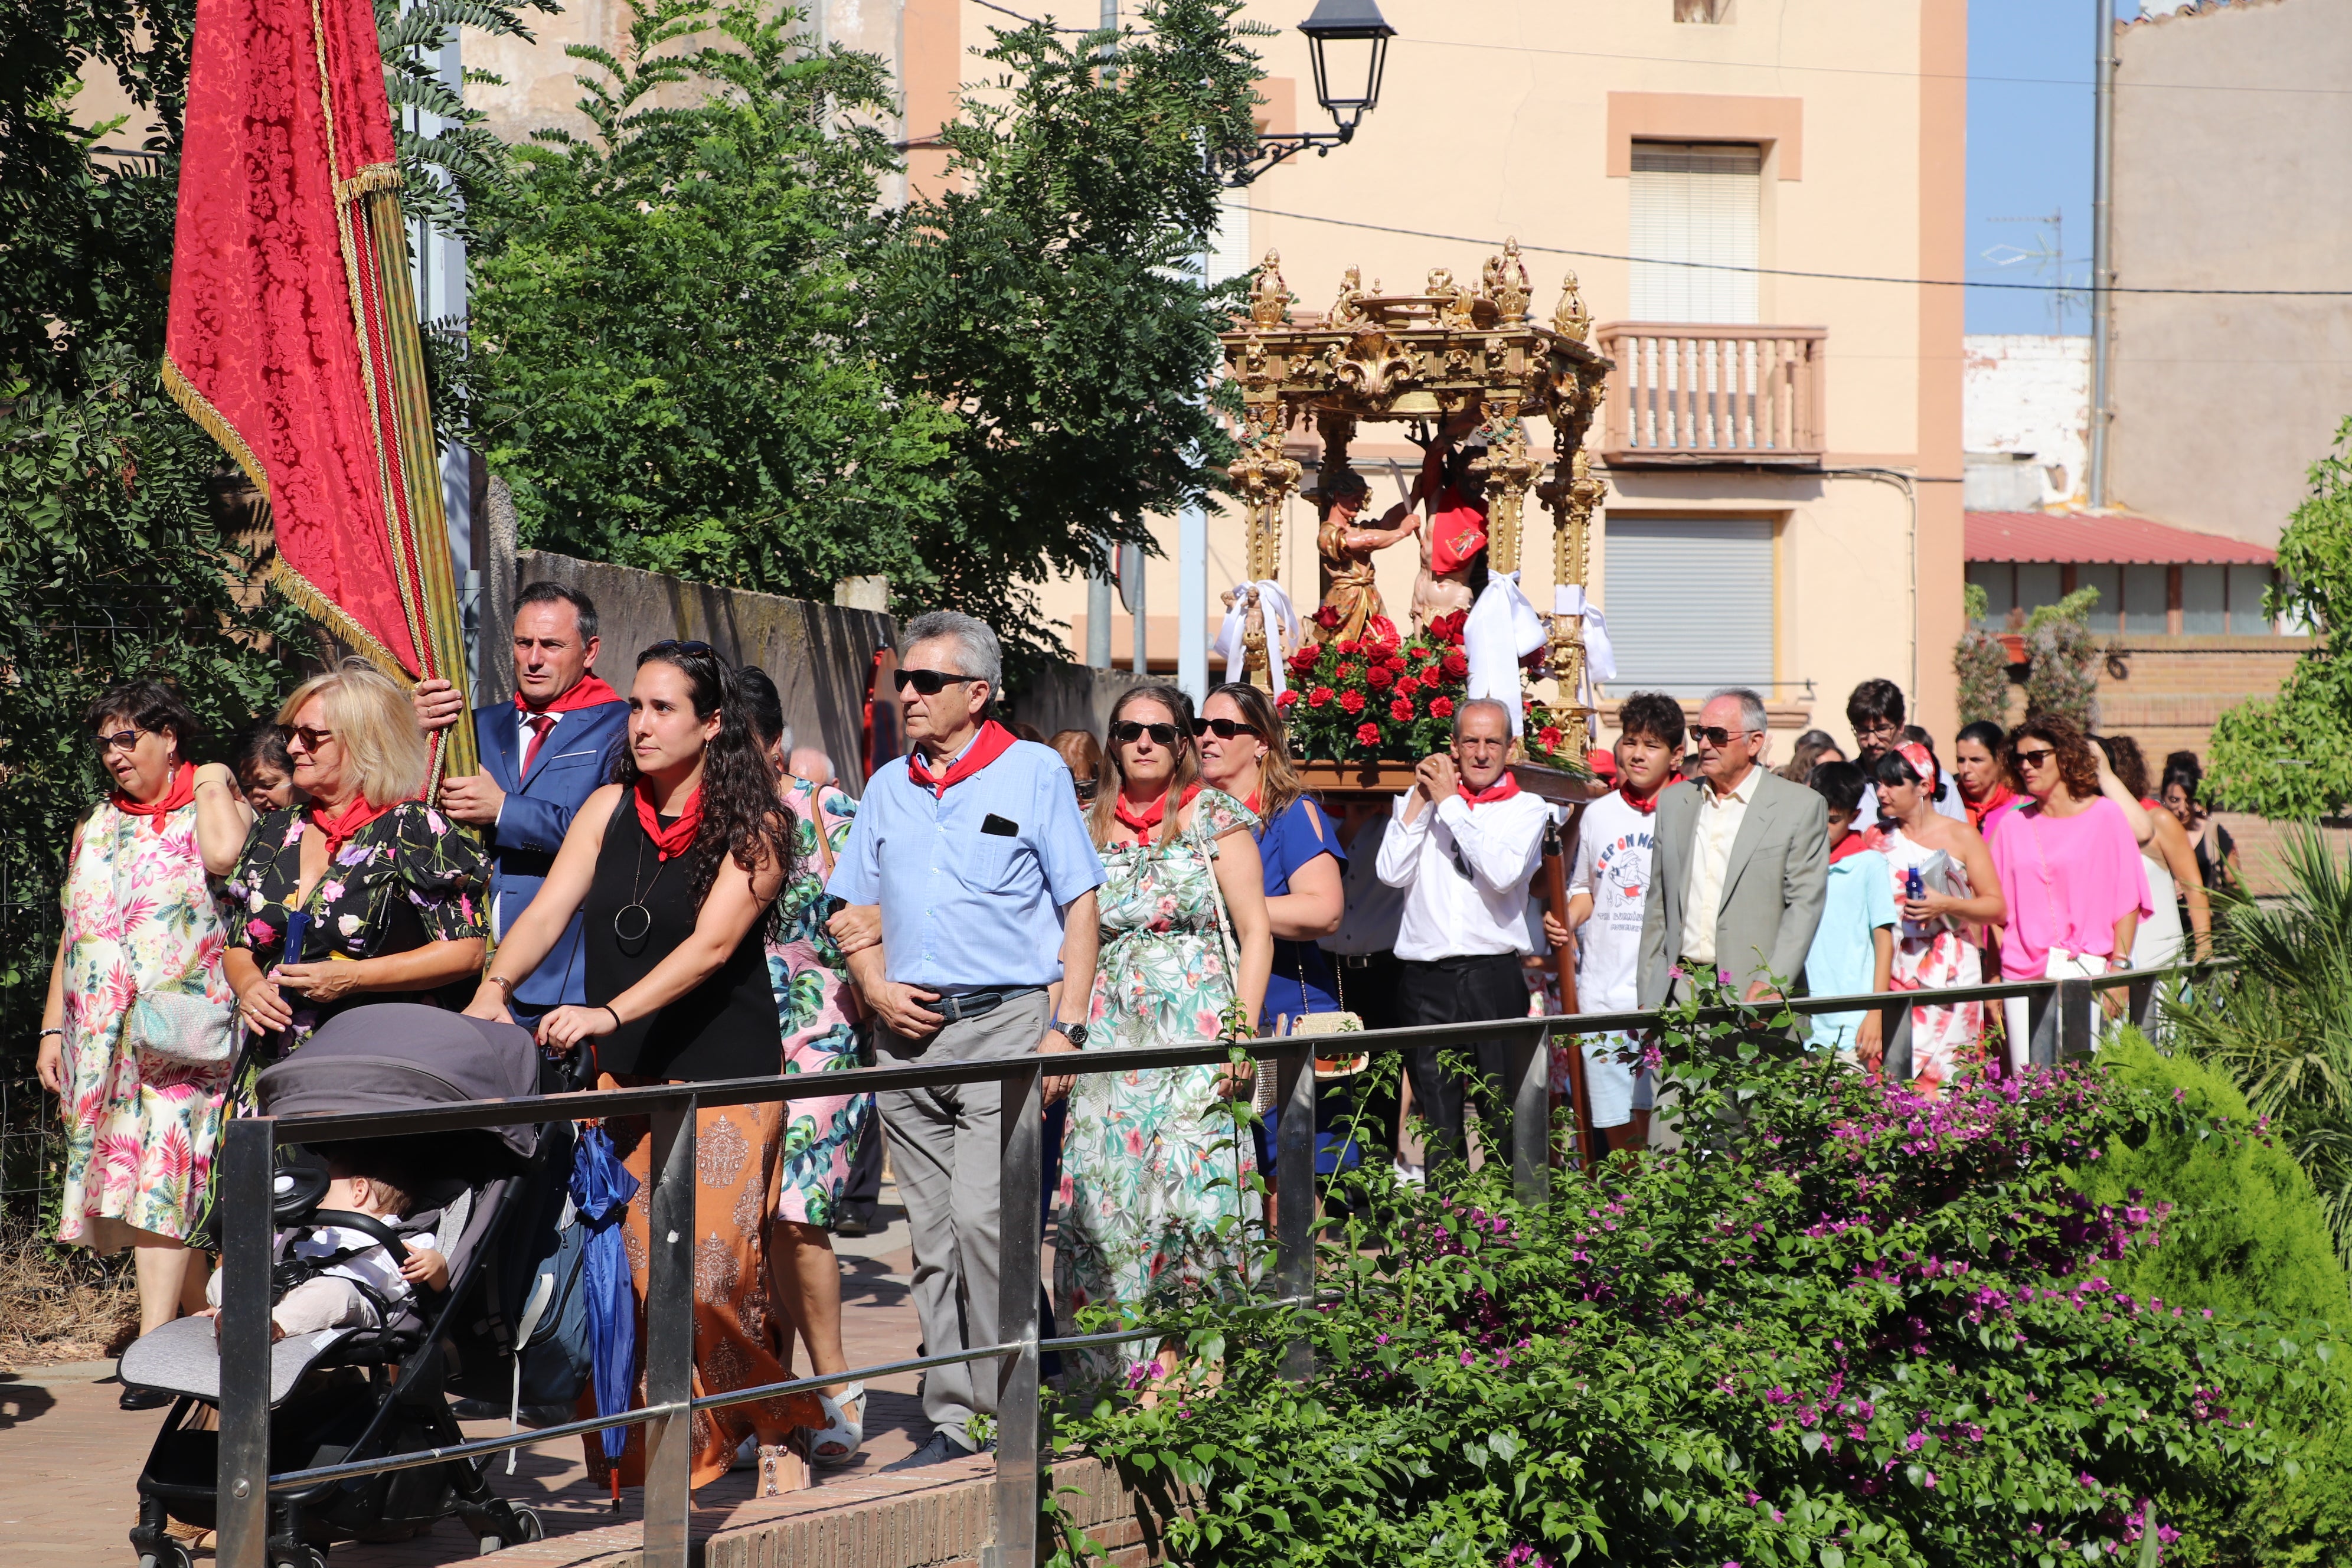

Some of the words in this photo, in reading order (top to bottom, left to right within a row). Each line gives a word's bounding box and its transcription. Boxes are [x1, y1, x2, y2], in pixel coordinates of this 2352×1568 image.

[1596, 844, 1615, 879] KEEP
[1618, 833, 1635, 851] ON
[1613, 912, 1644, 921] BURNIN
[1611, 923, 1642, 932] MOVEMEN
